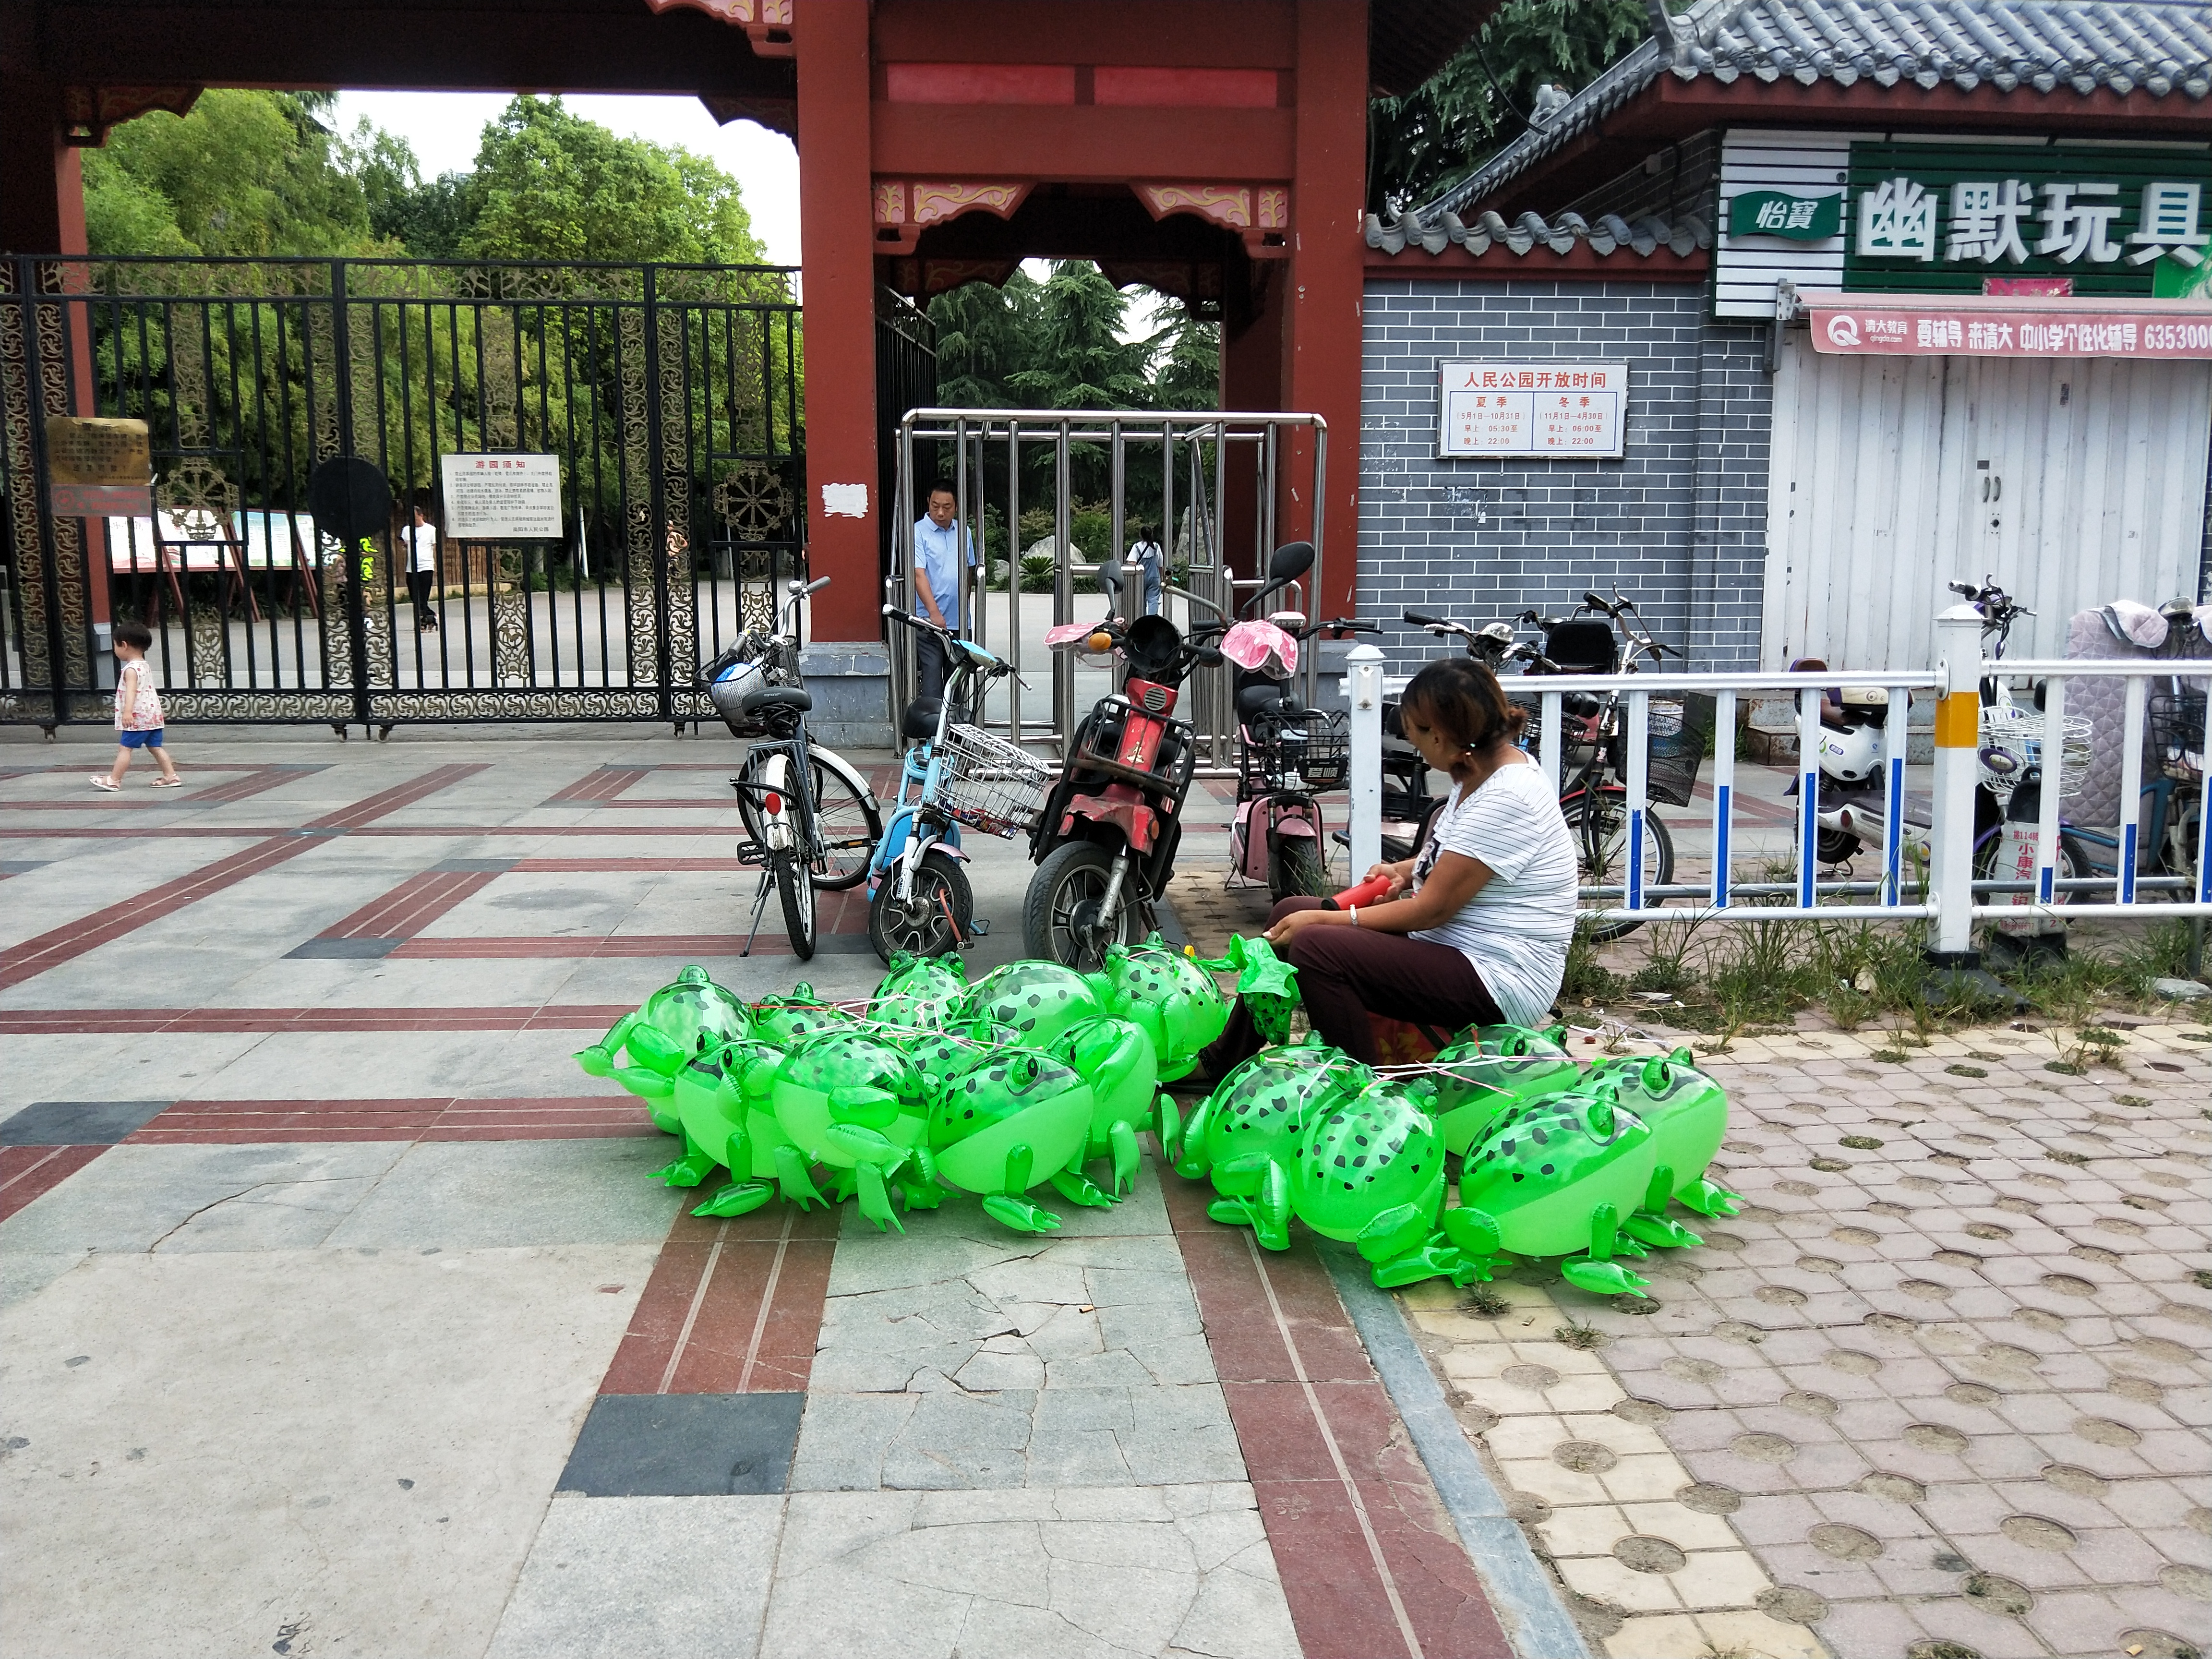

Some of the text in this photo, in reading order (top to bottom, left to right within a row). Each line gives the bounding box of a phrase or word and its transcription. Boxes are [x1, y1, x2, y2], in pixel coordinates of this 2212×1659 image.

[1755, 200, 1818, 229] 怡寶
[1855, 178, 2210, 267] 幽默玩具
[1865, 319, 1907, 335] 清大教育
[1917, 319, 1962, 348] 要辅导
[1968, 322, 2013, 350] 来清大
[2020, 323, 2137, 352] 中小学个性化辅导
[1464, 371, 1606, 389] 人民公园开放时间
[1476, 397, 1507, 408] 夏季
[1558, 397, 1590, 408] 冬季
[475, 460, 526, 469] 游园须知
